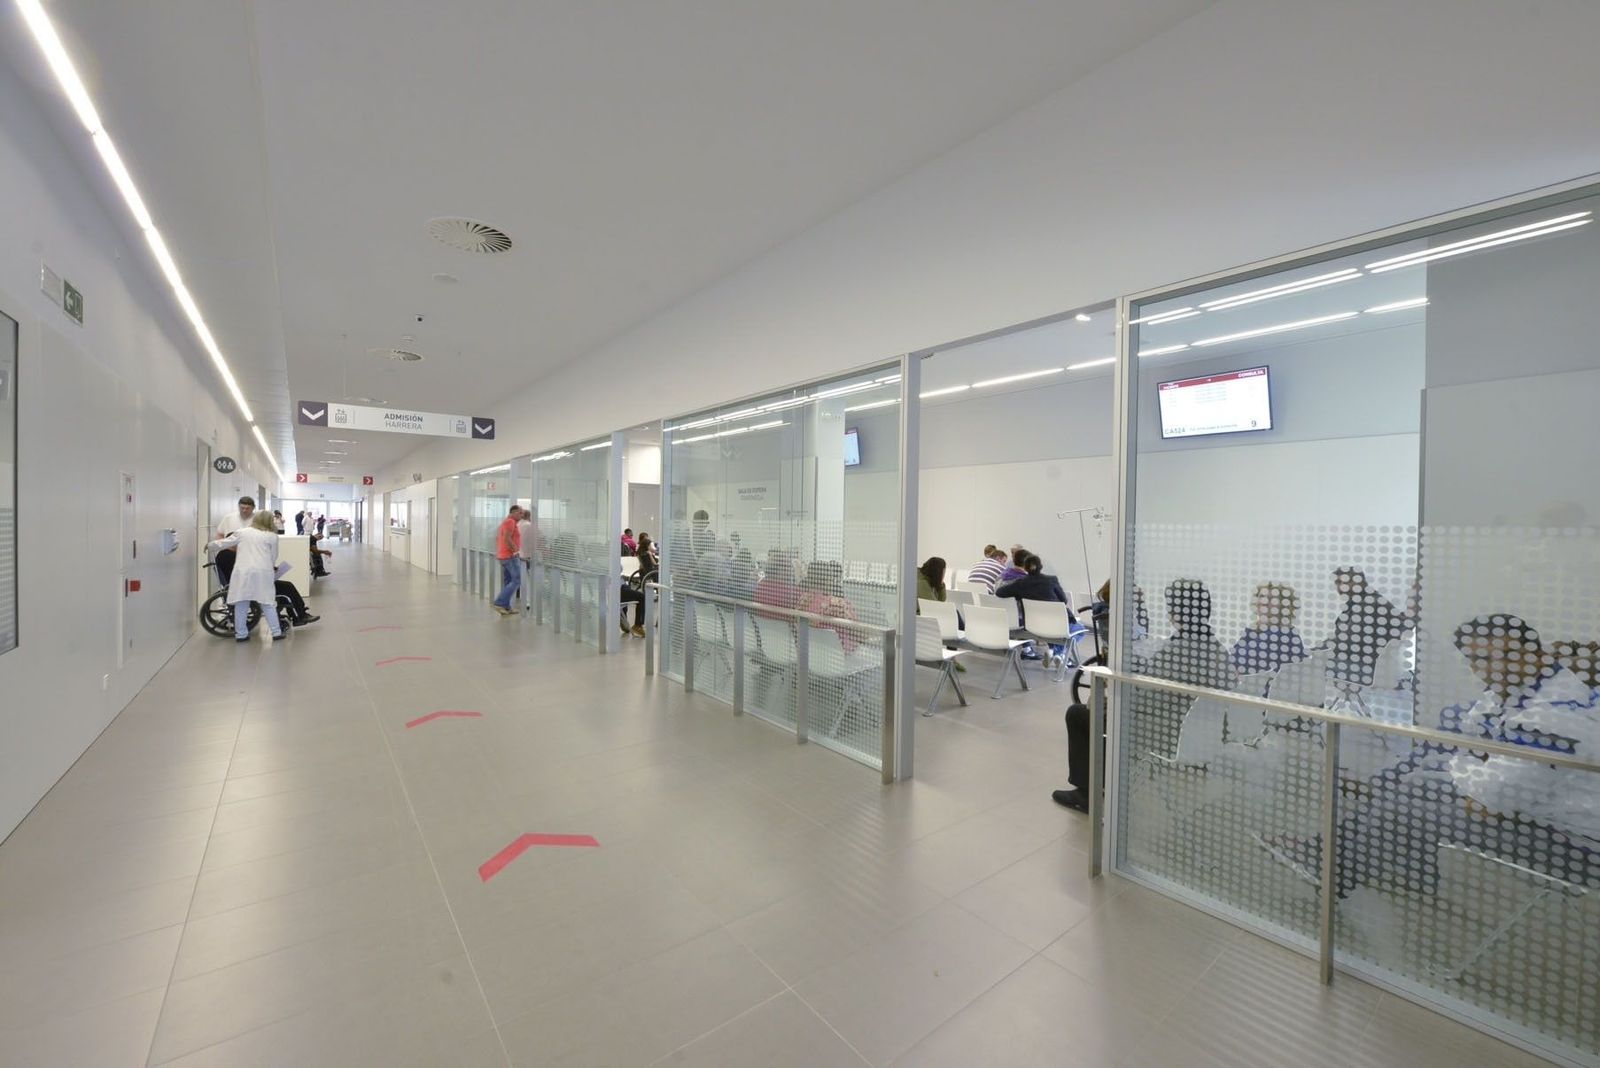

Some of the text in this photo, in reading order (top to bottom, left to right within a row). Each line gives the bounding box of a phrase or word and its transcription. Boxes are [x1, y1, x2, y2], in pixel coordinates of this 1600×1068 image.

[1237, 369, 1265, 379] CONSULTA
[384, 412, 424, 422] ADMISIÓN
[385, 420, 423, 430] HARRERA
